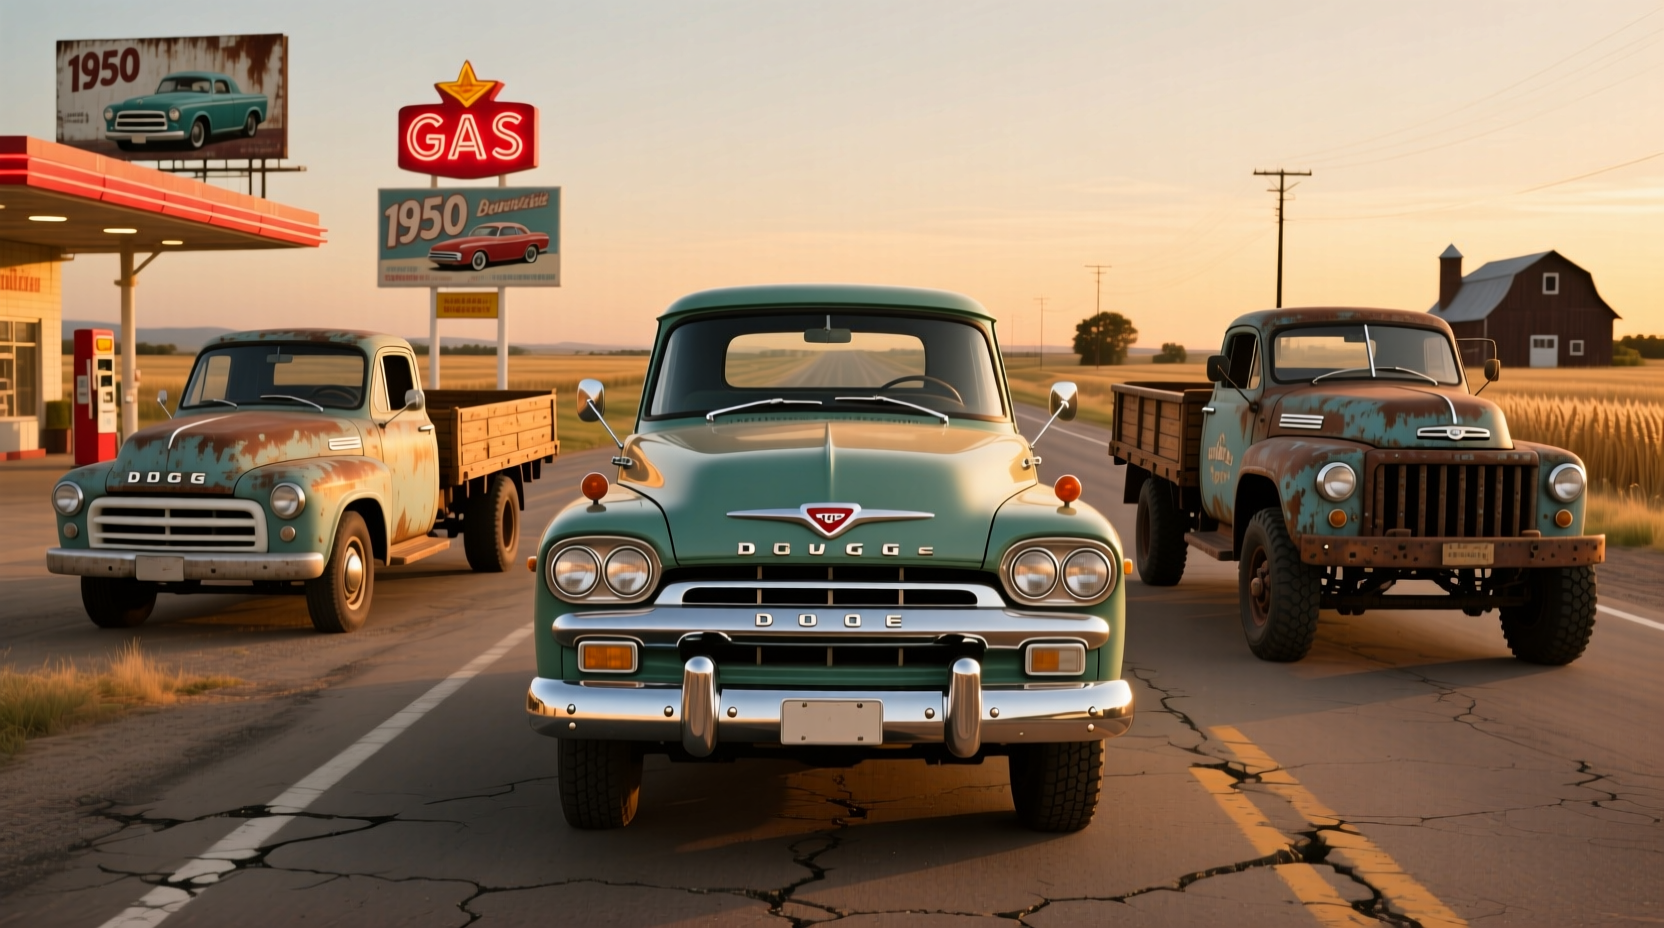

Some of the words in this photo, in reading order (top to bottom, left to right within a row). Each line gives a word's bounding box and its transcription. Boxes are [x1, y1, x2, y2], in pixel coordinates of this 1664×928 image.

[68, 47, 141, 93] 1950
[406, 112, 523, 161] GAS
[384, 193, 469, 249] 1950
[754, 612, 902, 627] DOOE
